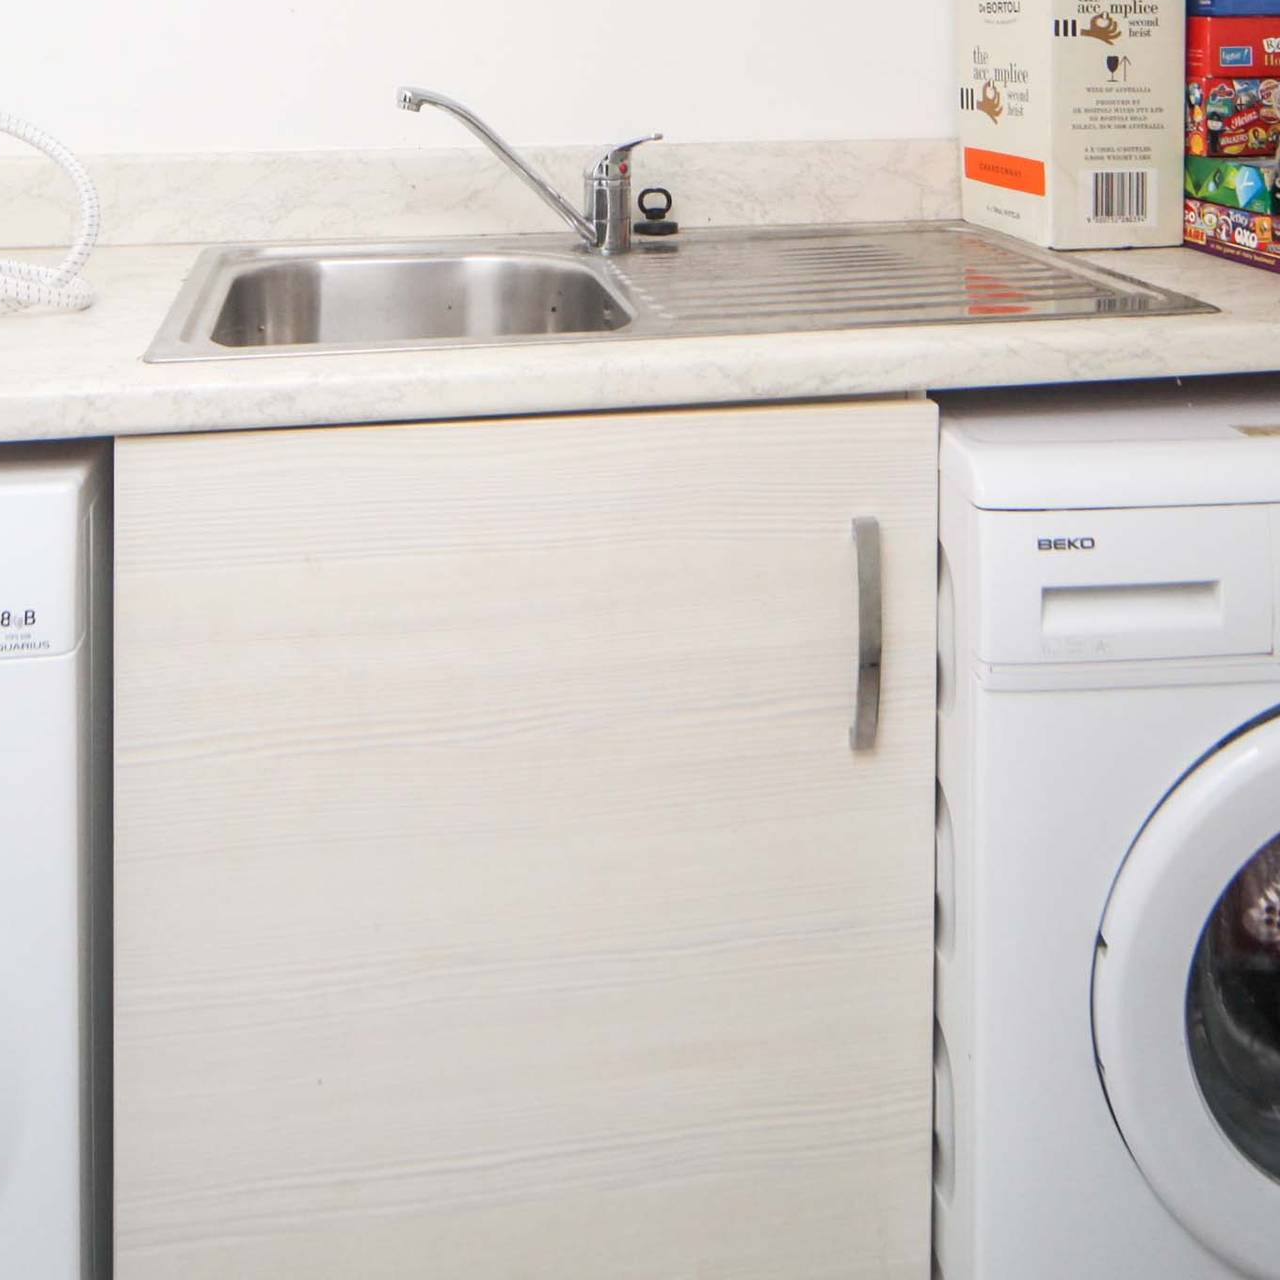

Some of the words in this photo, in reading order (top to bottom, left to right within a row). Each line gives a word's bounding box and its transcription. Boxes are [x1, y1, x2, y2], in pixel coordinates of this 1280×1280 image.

[1128, 17, 1159, 27] second
[1128, 28, 1152, 38] heist
[1231, 111, 1259, 129] Heinz
[1037, 537, 1095, 550] BEKO
[0, 610, 11, 627] 8
[24, 609, 36, 626] B
